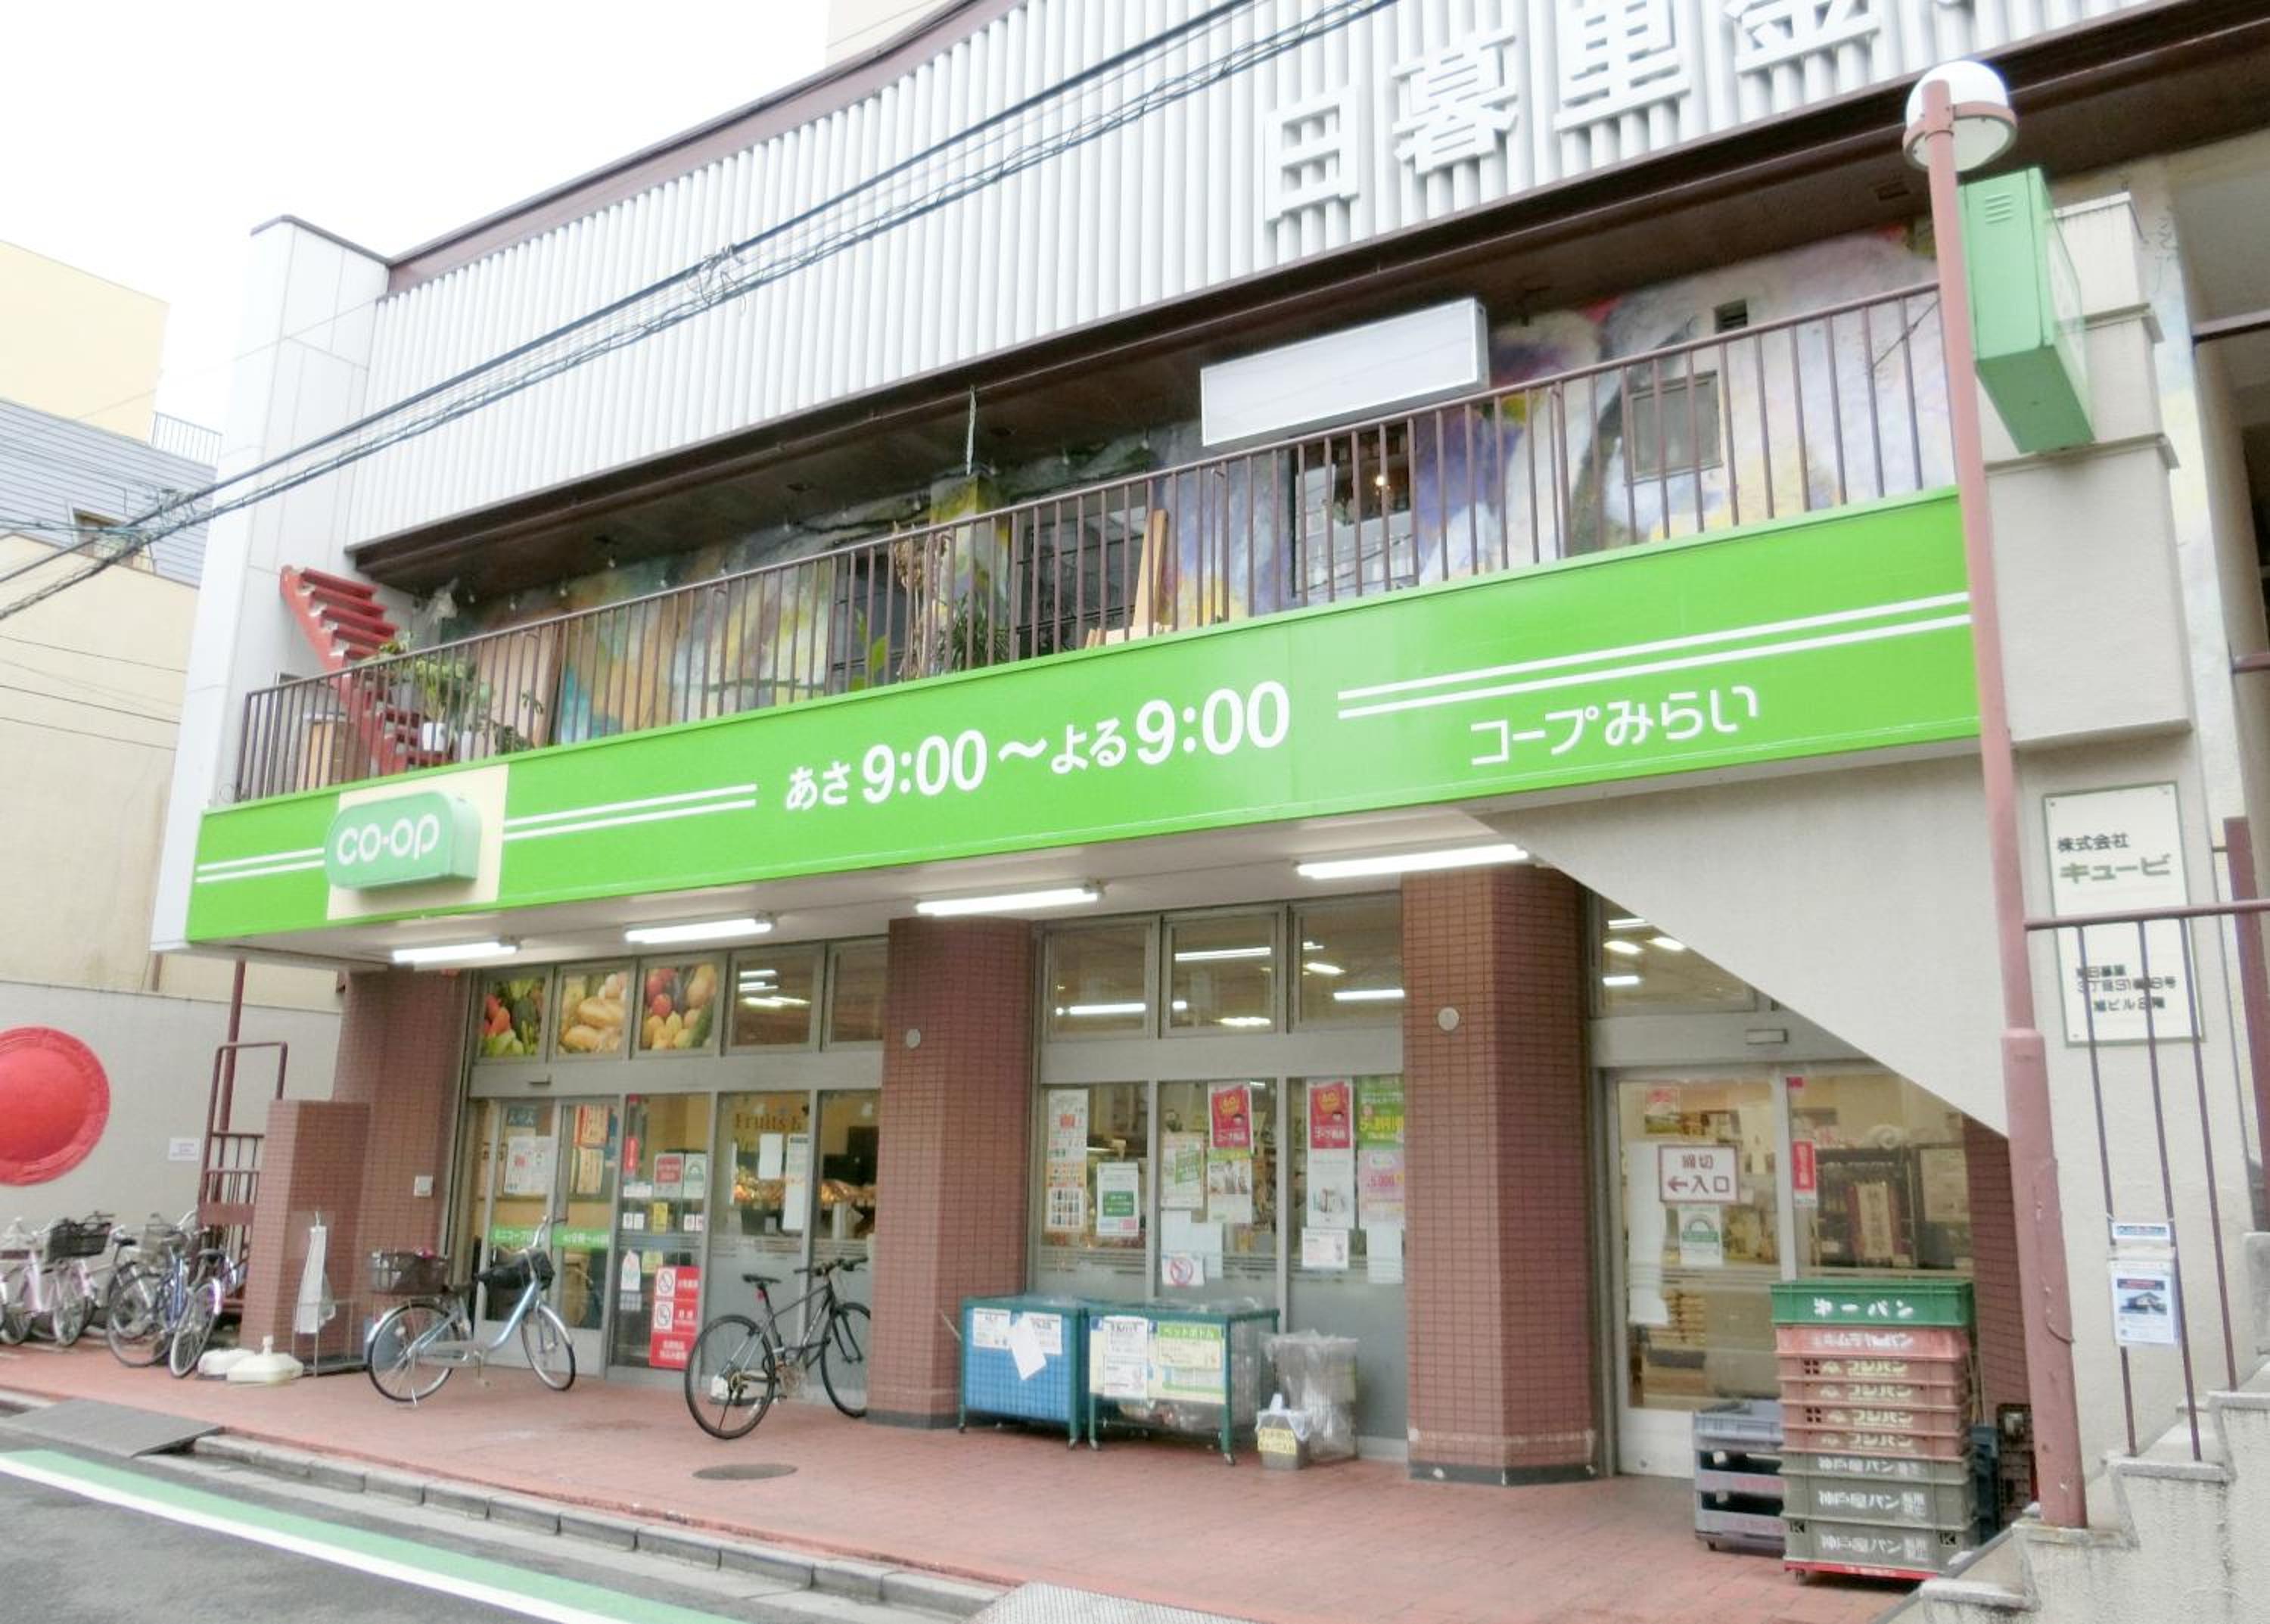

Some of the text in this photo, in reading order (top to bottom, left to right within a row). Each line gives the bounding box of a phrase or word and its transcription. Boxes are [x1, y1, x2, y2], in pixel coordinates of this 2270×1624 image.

[1470, 684, 1759, 766] コープみらい
[2057, 832, 2130, 853] 株式会社
[1691, 1174, 1730, 1193] 入口
